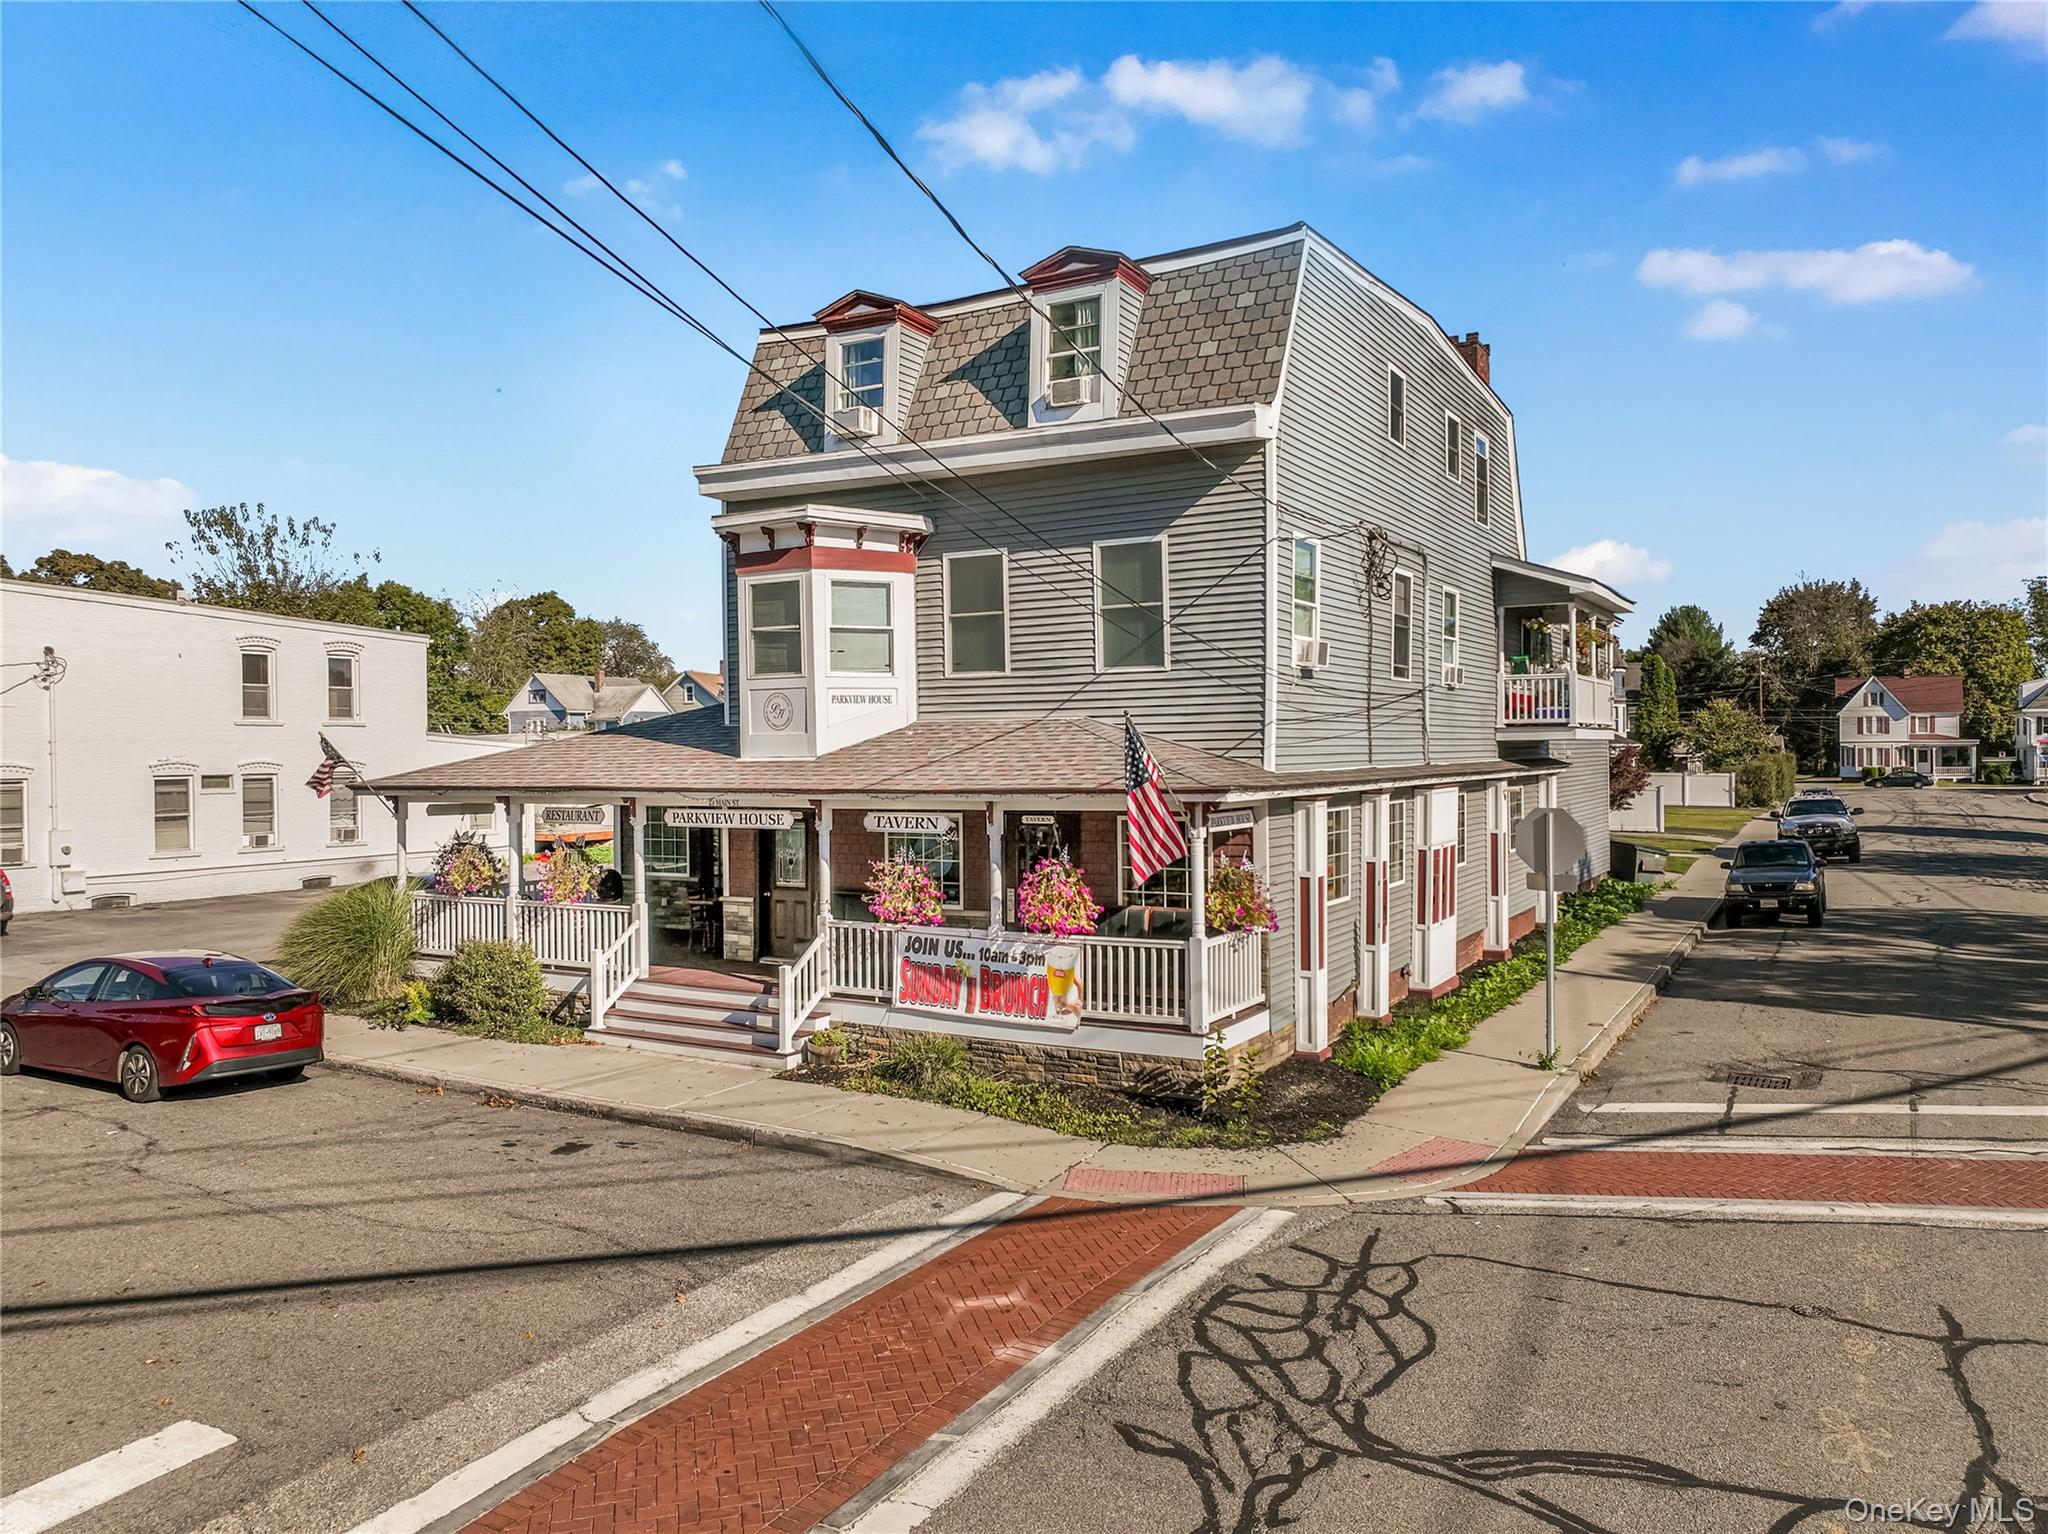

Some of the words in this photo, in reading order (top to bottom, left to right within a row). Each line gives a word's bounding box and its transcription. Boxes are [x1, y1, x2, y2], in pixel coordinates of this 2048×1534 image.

[831, 694, 866, 705] PARKVIEW
[868, 694, 893, 705] HOUSE
[545, 808, 601, 823] RESTAURANT
[672, 812, 735, 826] PARKVIEW
[739, 812, 785, 826] HOUSE
[873, 815, 940, 830] TAVERN
[904, 935, 940, 955] JOIN
[944, 939, 976, 960] US...
[978, 947, 1009, 964] 10am
[1018, 951, 1046, 967] 3pm
[899, 955, 963, 1010] SUNDAY
[979, 964, 1049, 1021] BRUNCH
